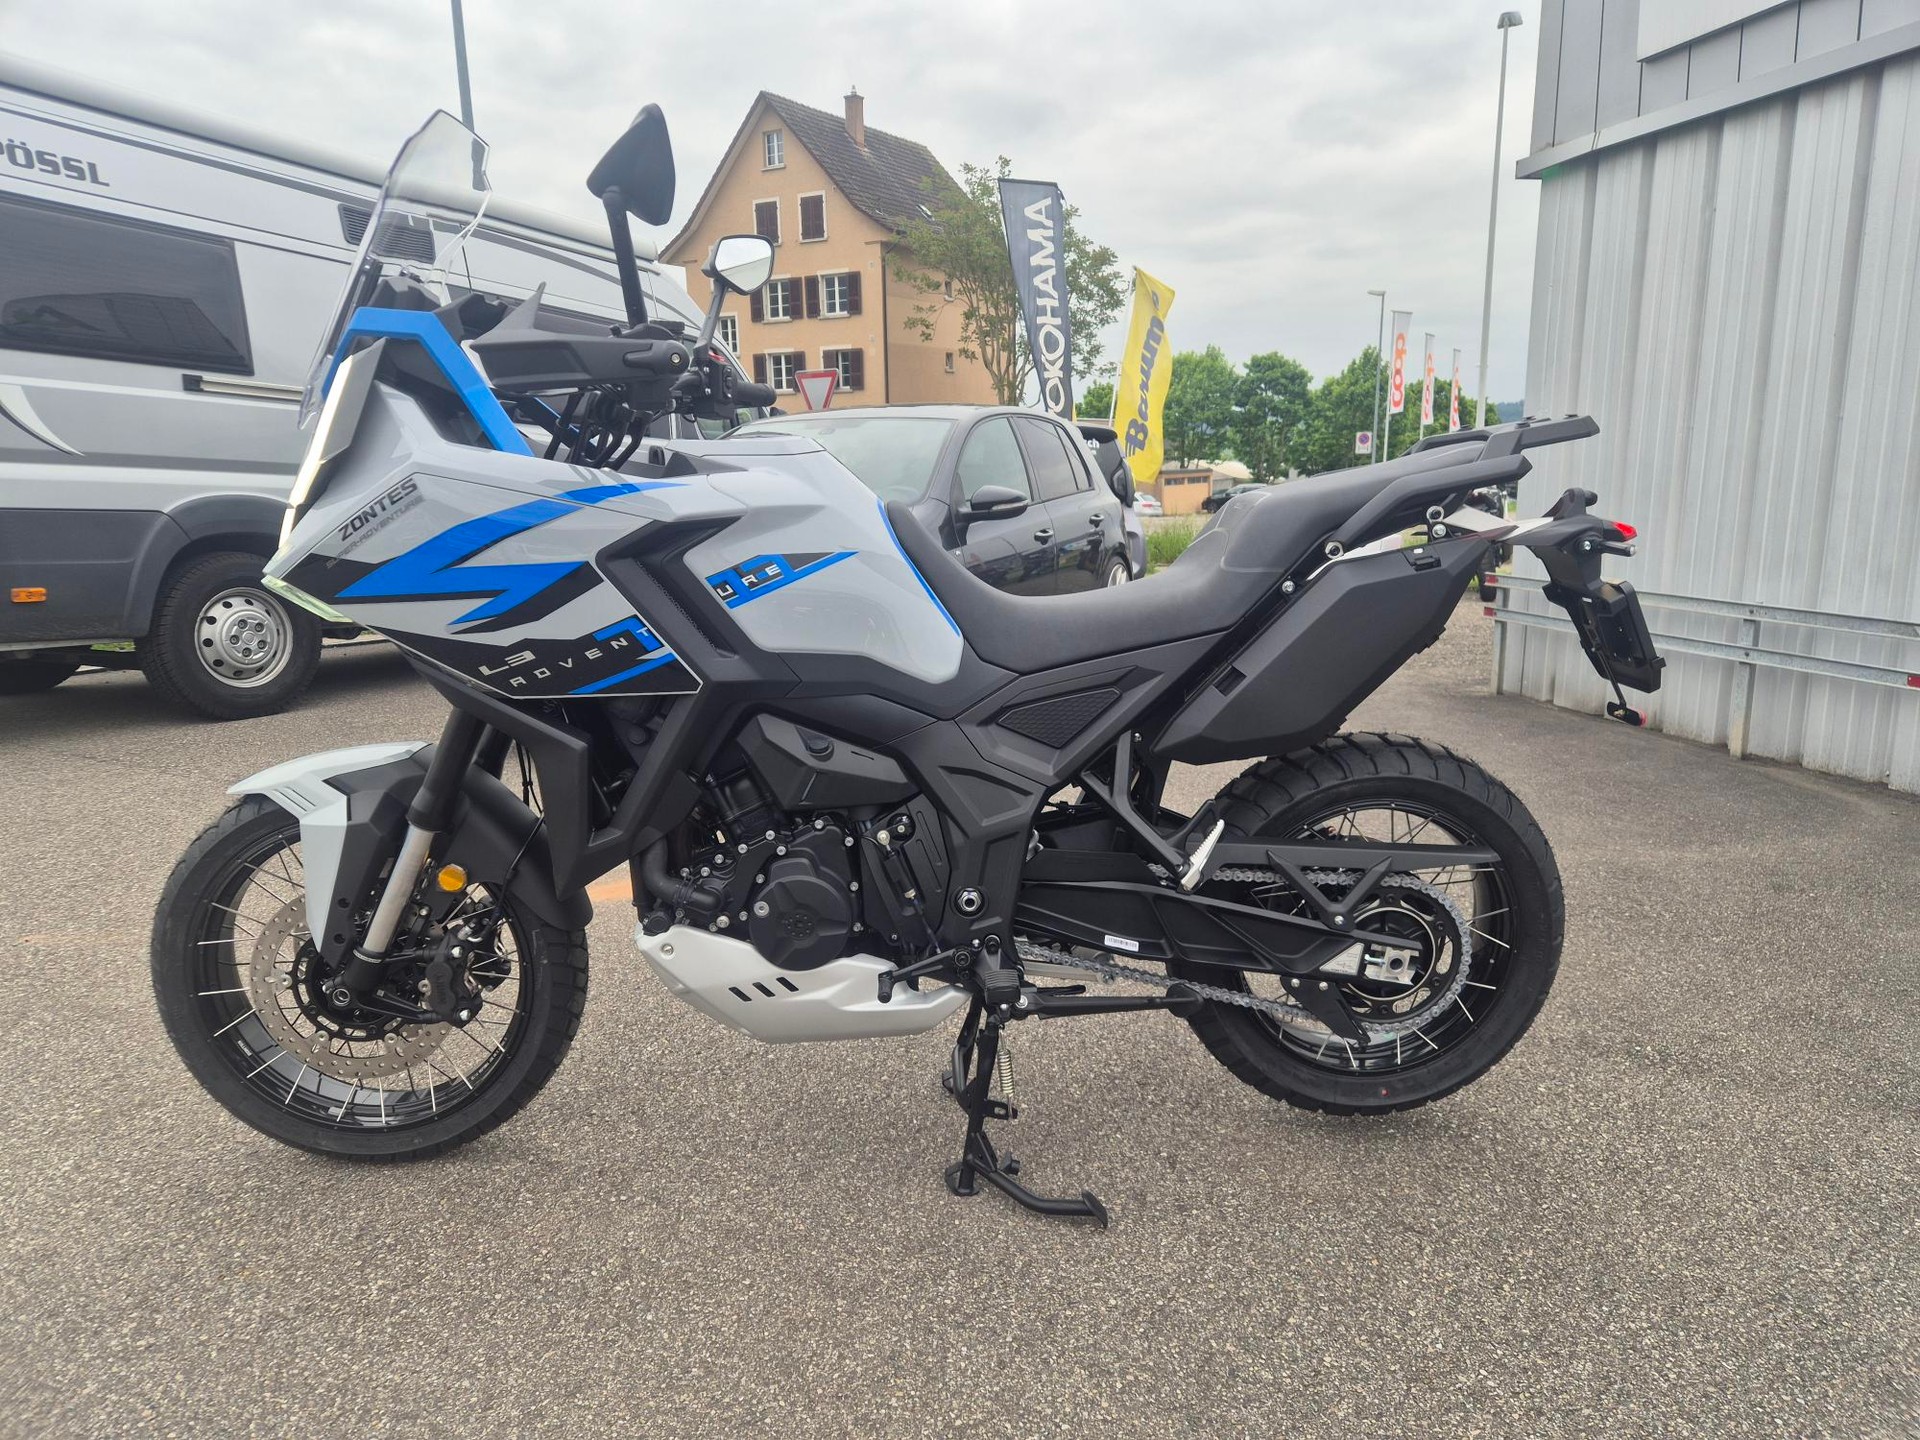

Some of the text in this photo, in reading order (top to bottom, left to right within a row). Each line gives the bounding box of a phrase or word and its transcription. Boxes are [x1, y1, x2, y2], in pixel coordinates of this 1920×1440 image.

[1024, 197, 1066, 413] OKOHAMA
[1124, 314, 1165, 457] Barum
[1392, 333, 1406, 408] coop
[338, 478, 418, 542] ZONTES
